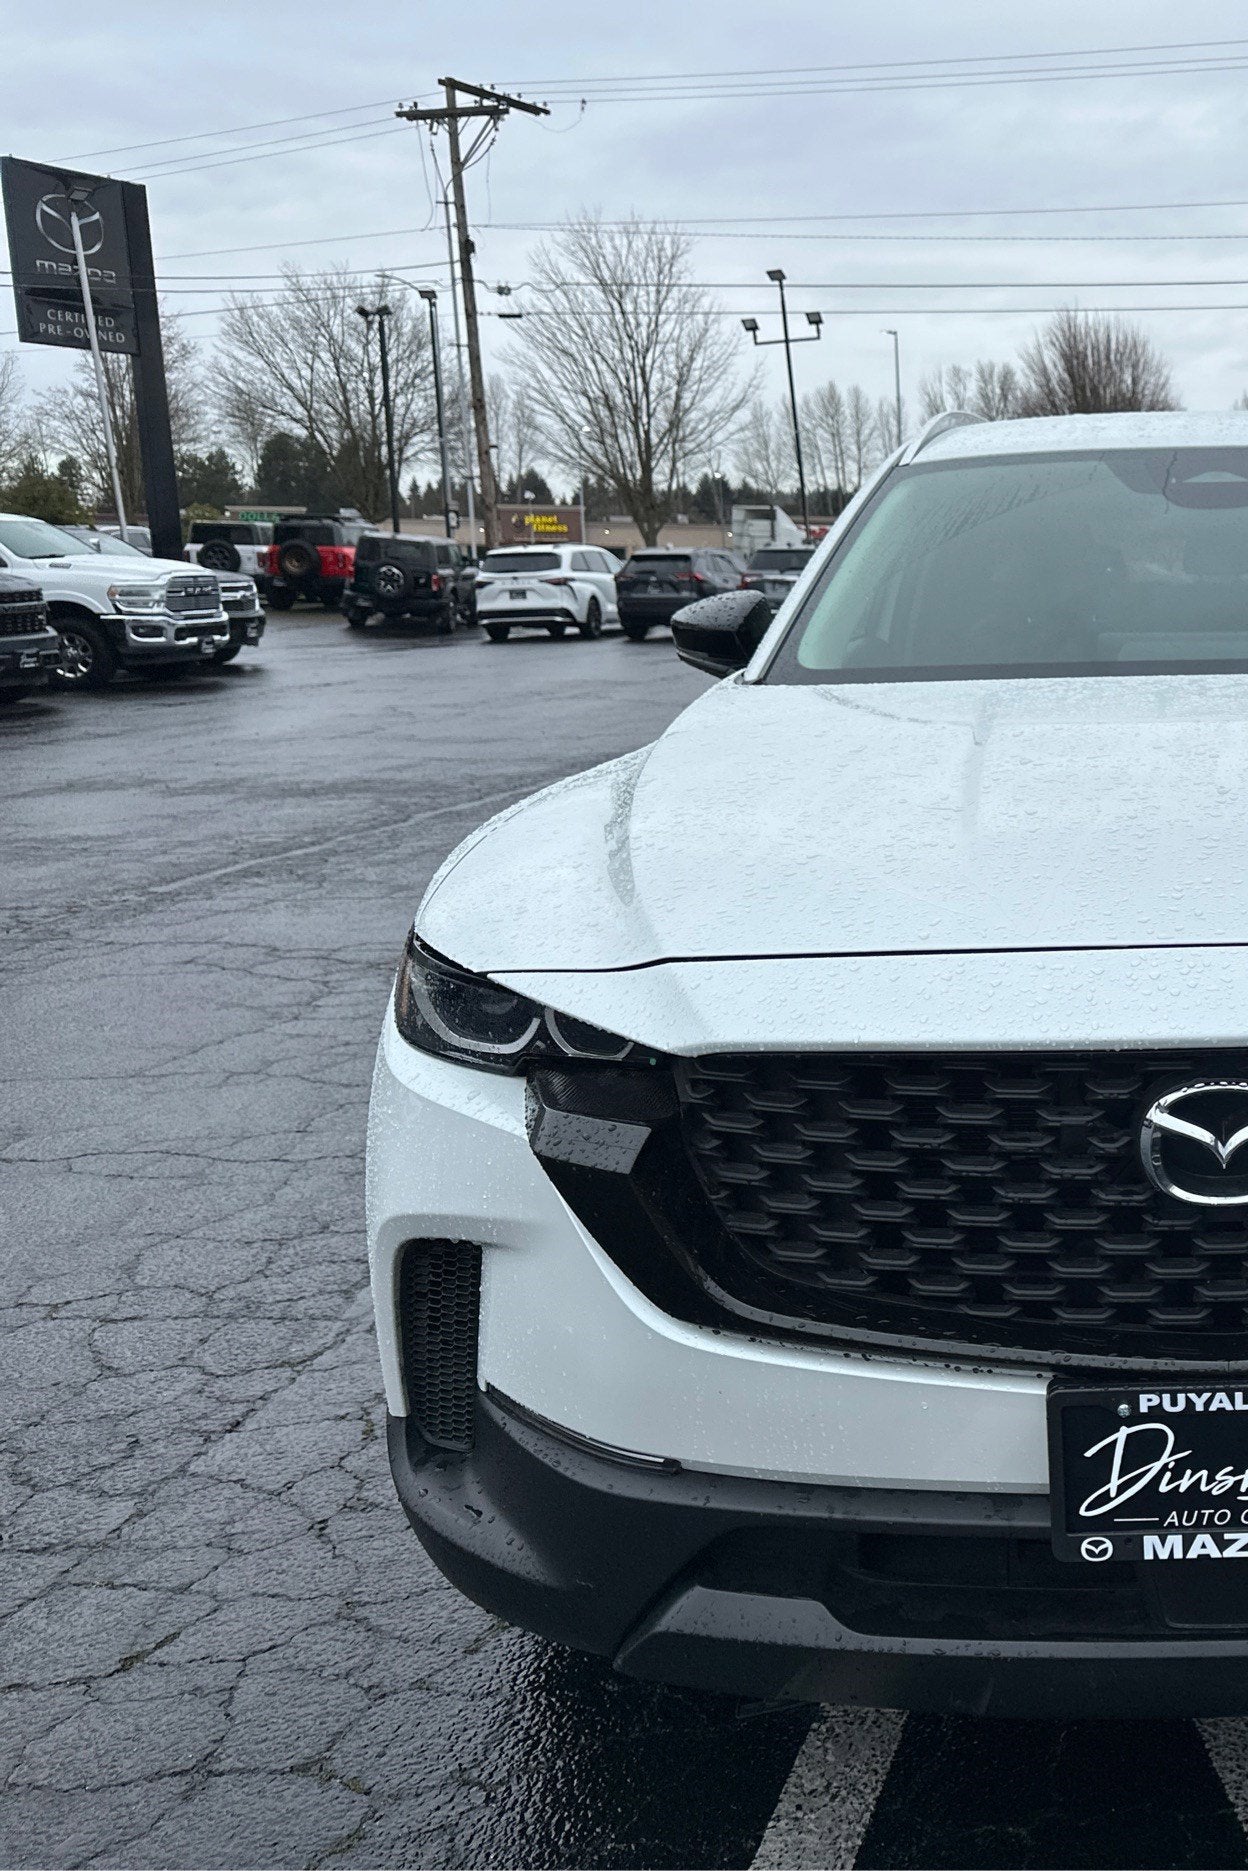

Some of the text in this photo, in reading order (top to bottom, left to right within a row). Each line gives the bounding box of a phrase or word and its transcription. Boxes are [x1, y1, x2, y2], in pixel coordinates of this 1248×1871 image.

[47, 309, 115, 328] CERTIED
[524, 512, 558, 526] planet
[533, 524, 569, 533] fitness
[1163, 1509, 1232, 1527] AUTO
